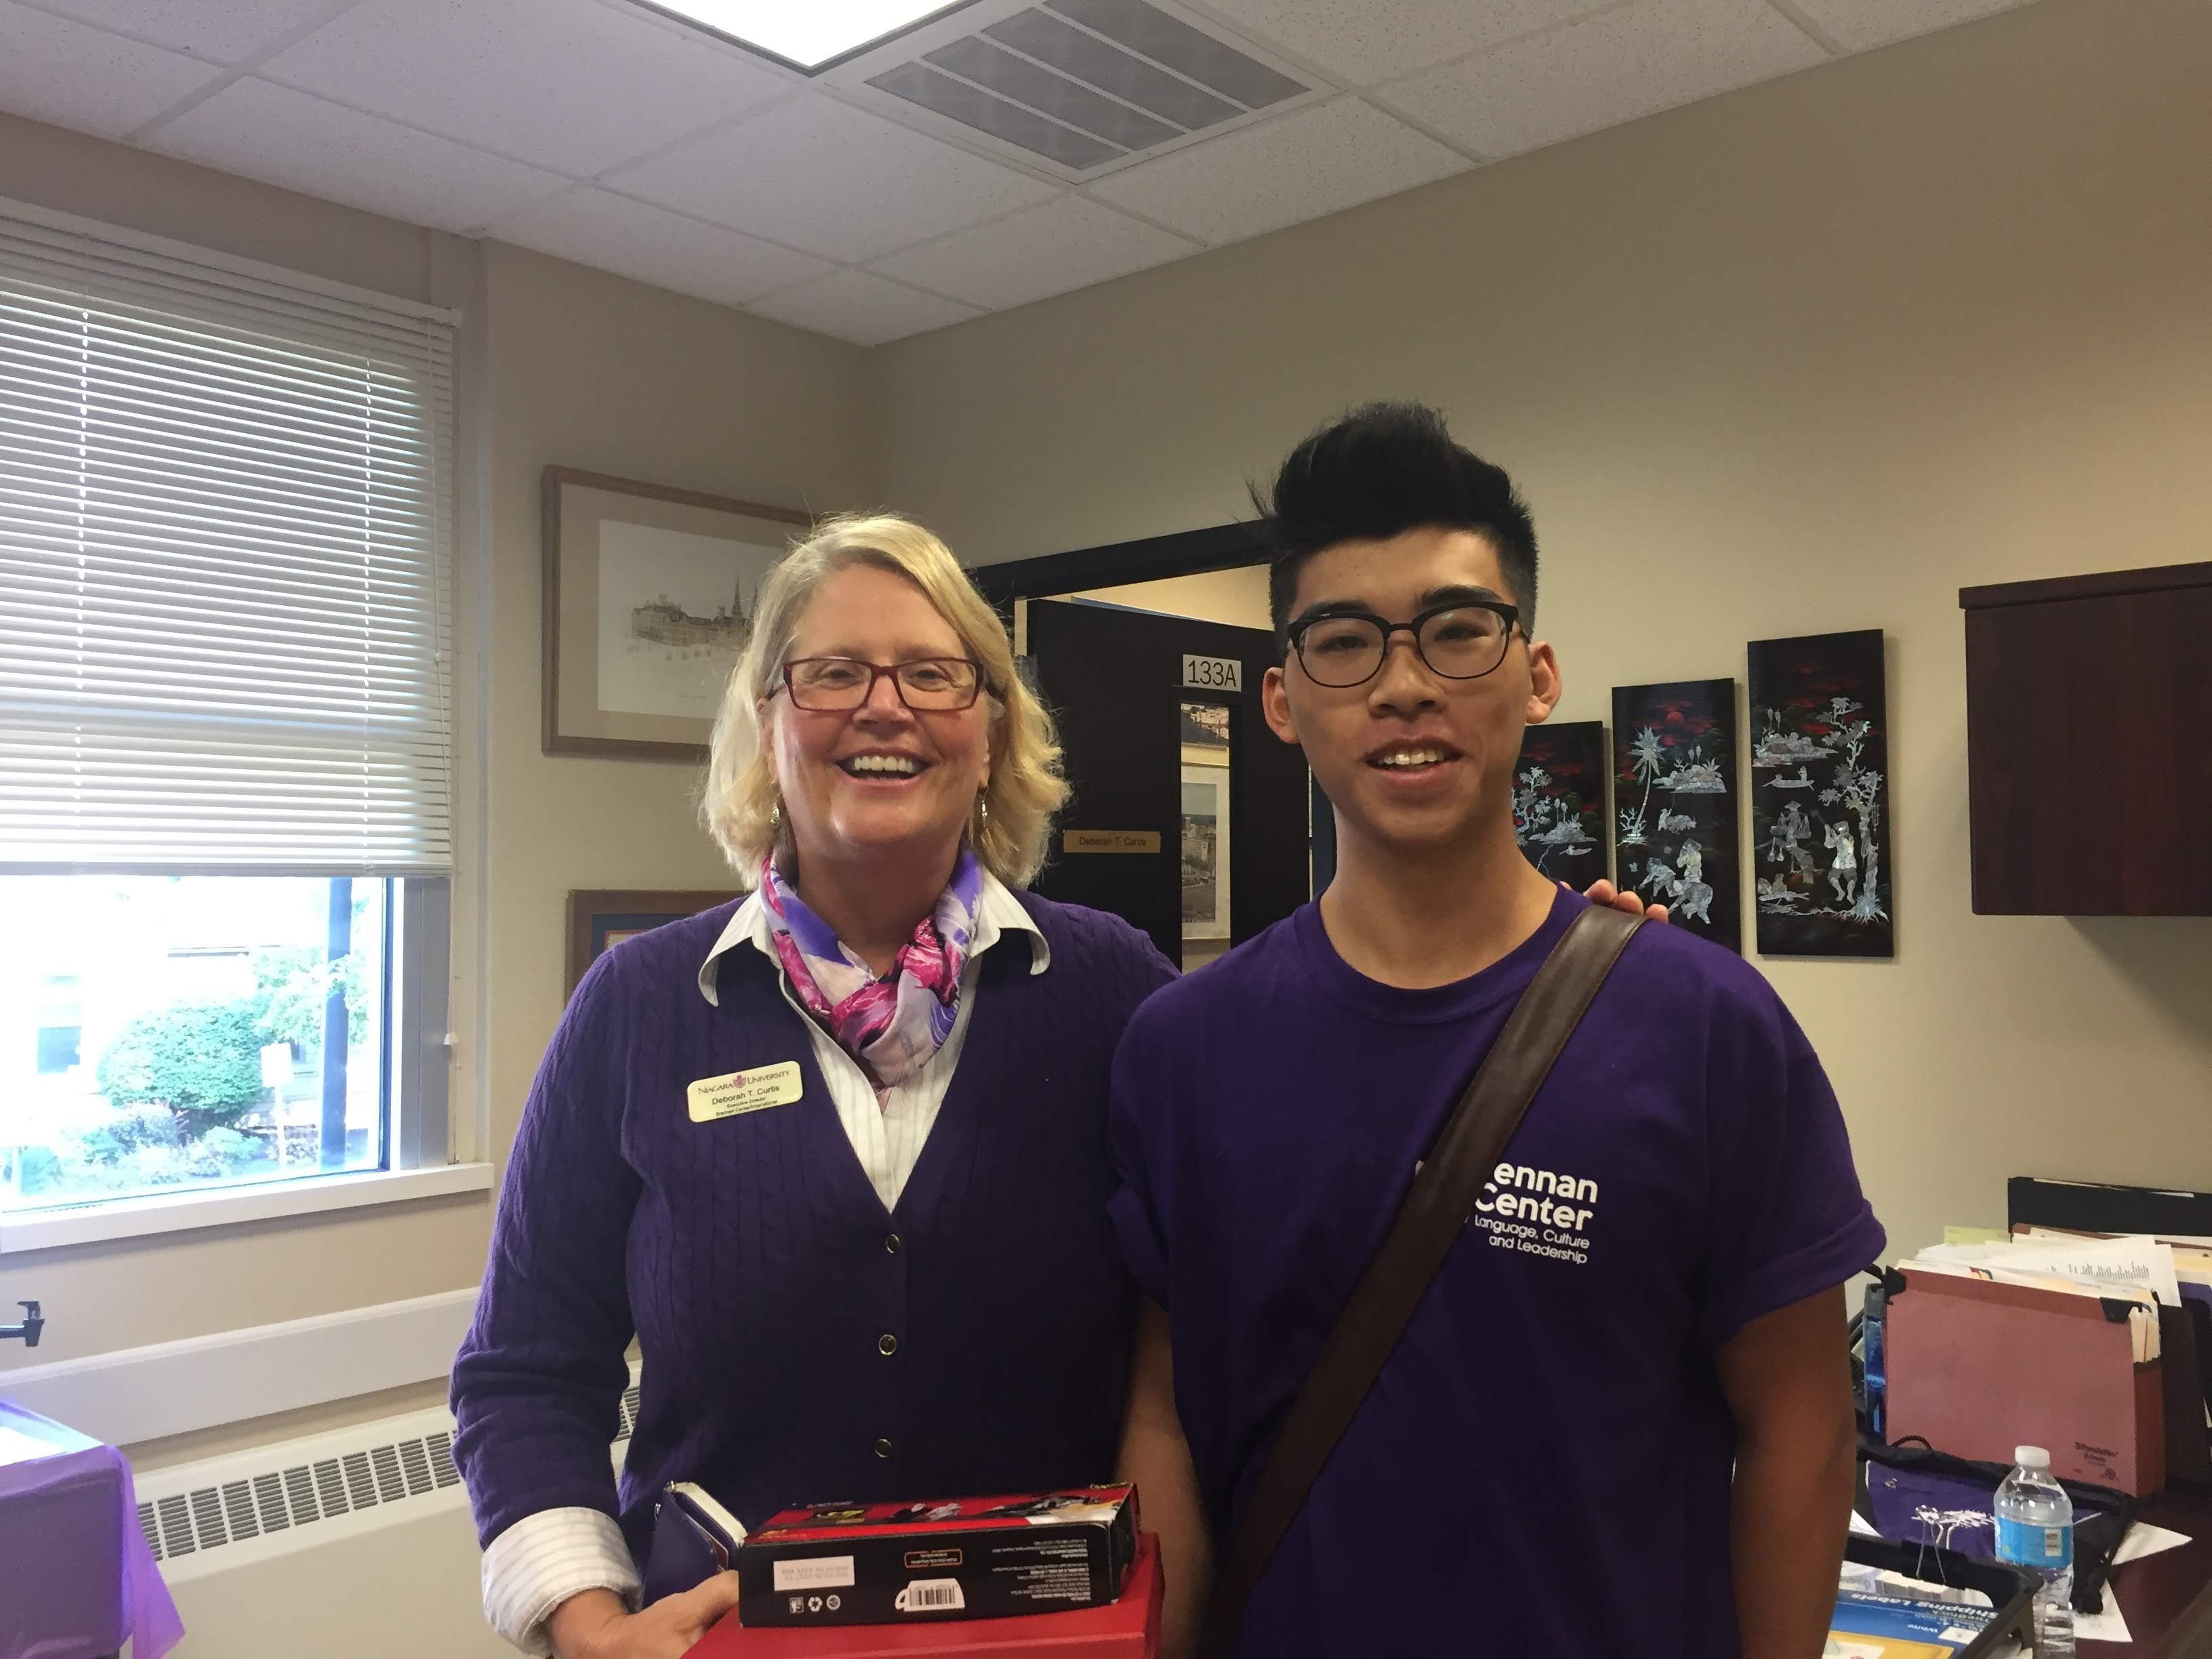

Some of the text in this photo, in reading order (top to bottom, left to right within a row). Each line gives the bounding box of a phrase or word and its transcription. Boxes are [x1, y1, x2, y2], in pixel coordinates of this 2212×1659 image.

[1188, 659, 1237, 688] 133A
[1079, 836, 1112, 846] Deborah
[1124, 836, 1147, 846] Curtis
[697, 1069, 791, 1095] NIAGARA UNIVERSITY
[712, 1092, 745, 1105] Deborah
[757, 1086, 780, 1096] Curtis
[1494, 1162, 1598, 1204] ennan
[1489, 1234, 1587, 1265] and Leadership
[1543, 1229, 1590, 1250] Culture
[1850, 1593, 1912, 1606] Labels
[1914, 1600, 1999, 1619] Shipping
